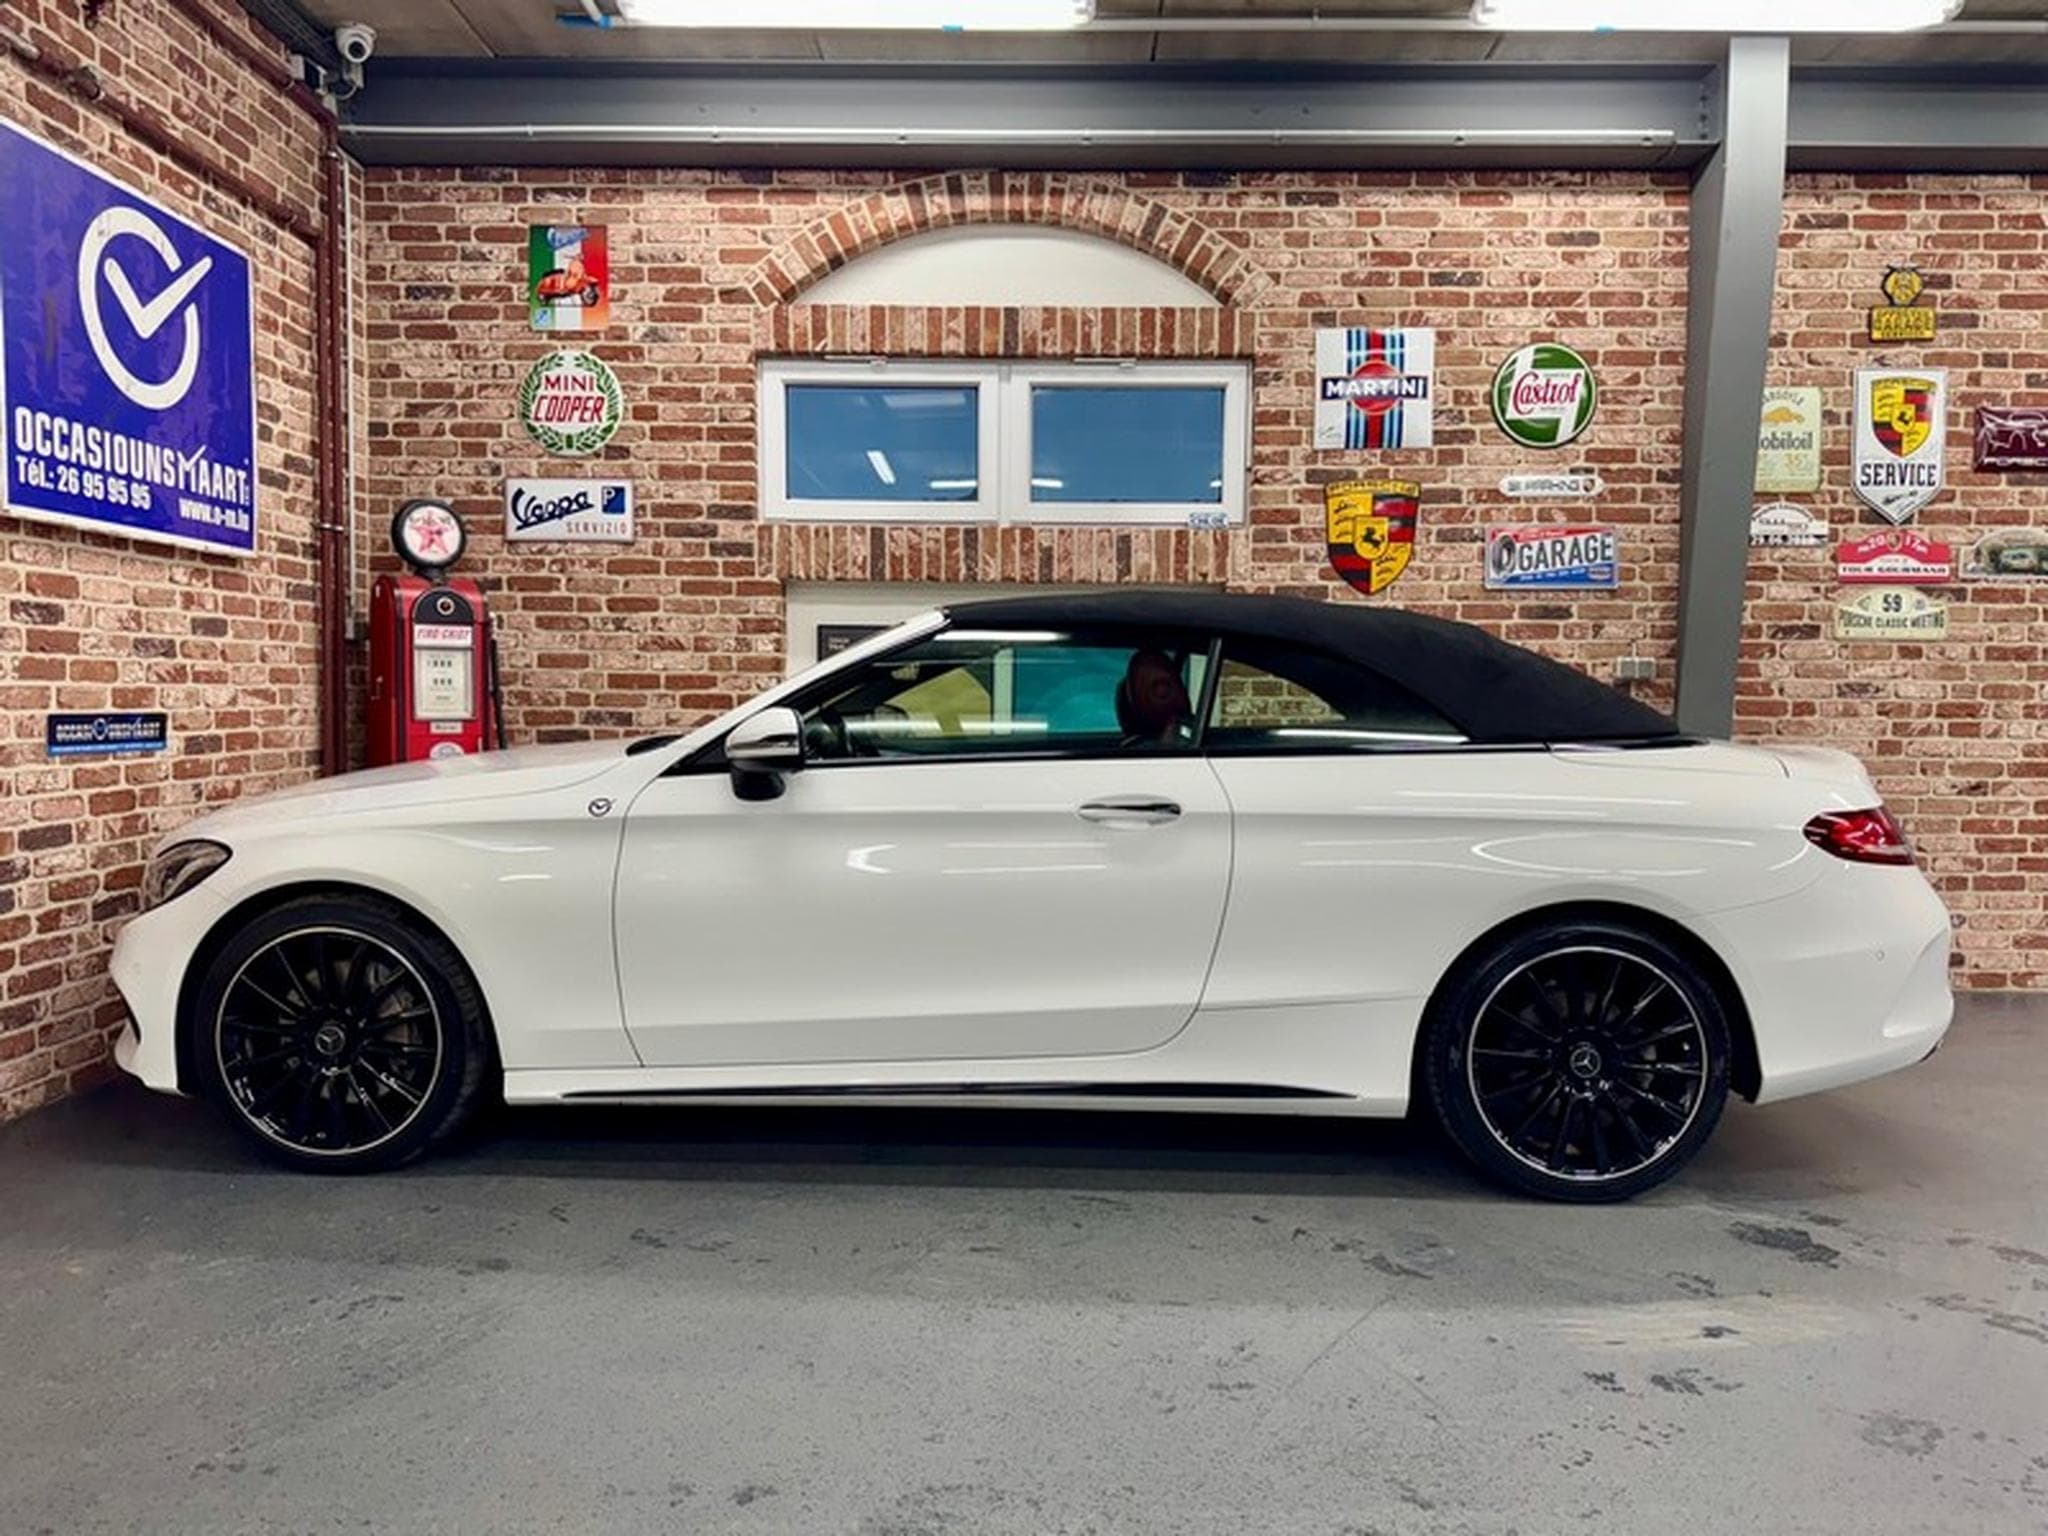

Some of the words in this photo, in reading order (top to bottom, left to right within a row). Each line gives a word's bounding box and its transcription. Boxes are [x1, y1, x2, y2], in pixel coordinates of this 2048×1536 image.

[545, 375, 594, 391] MINI
[1326, 379, 1424, 397] MARTINI
[1513, 371, 1582, 415] Castrol
[534, 396, 605, 422] COOPER
[1761, 432, 1813, 450] obiloil
[1984, 457, 2048, 467] PORSC
[1860, 463, 1937, 487] SERVICE
[57, 465, 80, 495] 26
[83, 471, 105, 501] 95
[107, 477, 129, 506] 95
[131, 483, 152, 510] 95
[511, 487, 595, 531] Vespa
[565, 522, 627, 534] SERVIZIO
[1519, 534, 1613, 572] GARAGE
